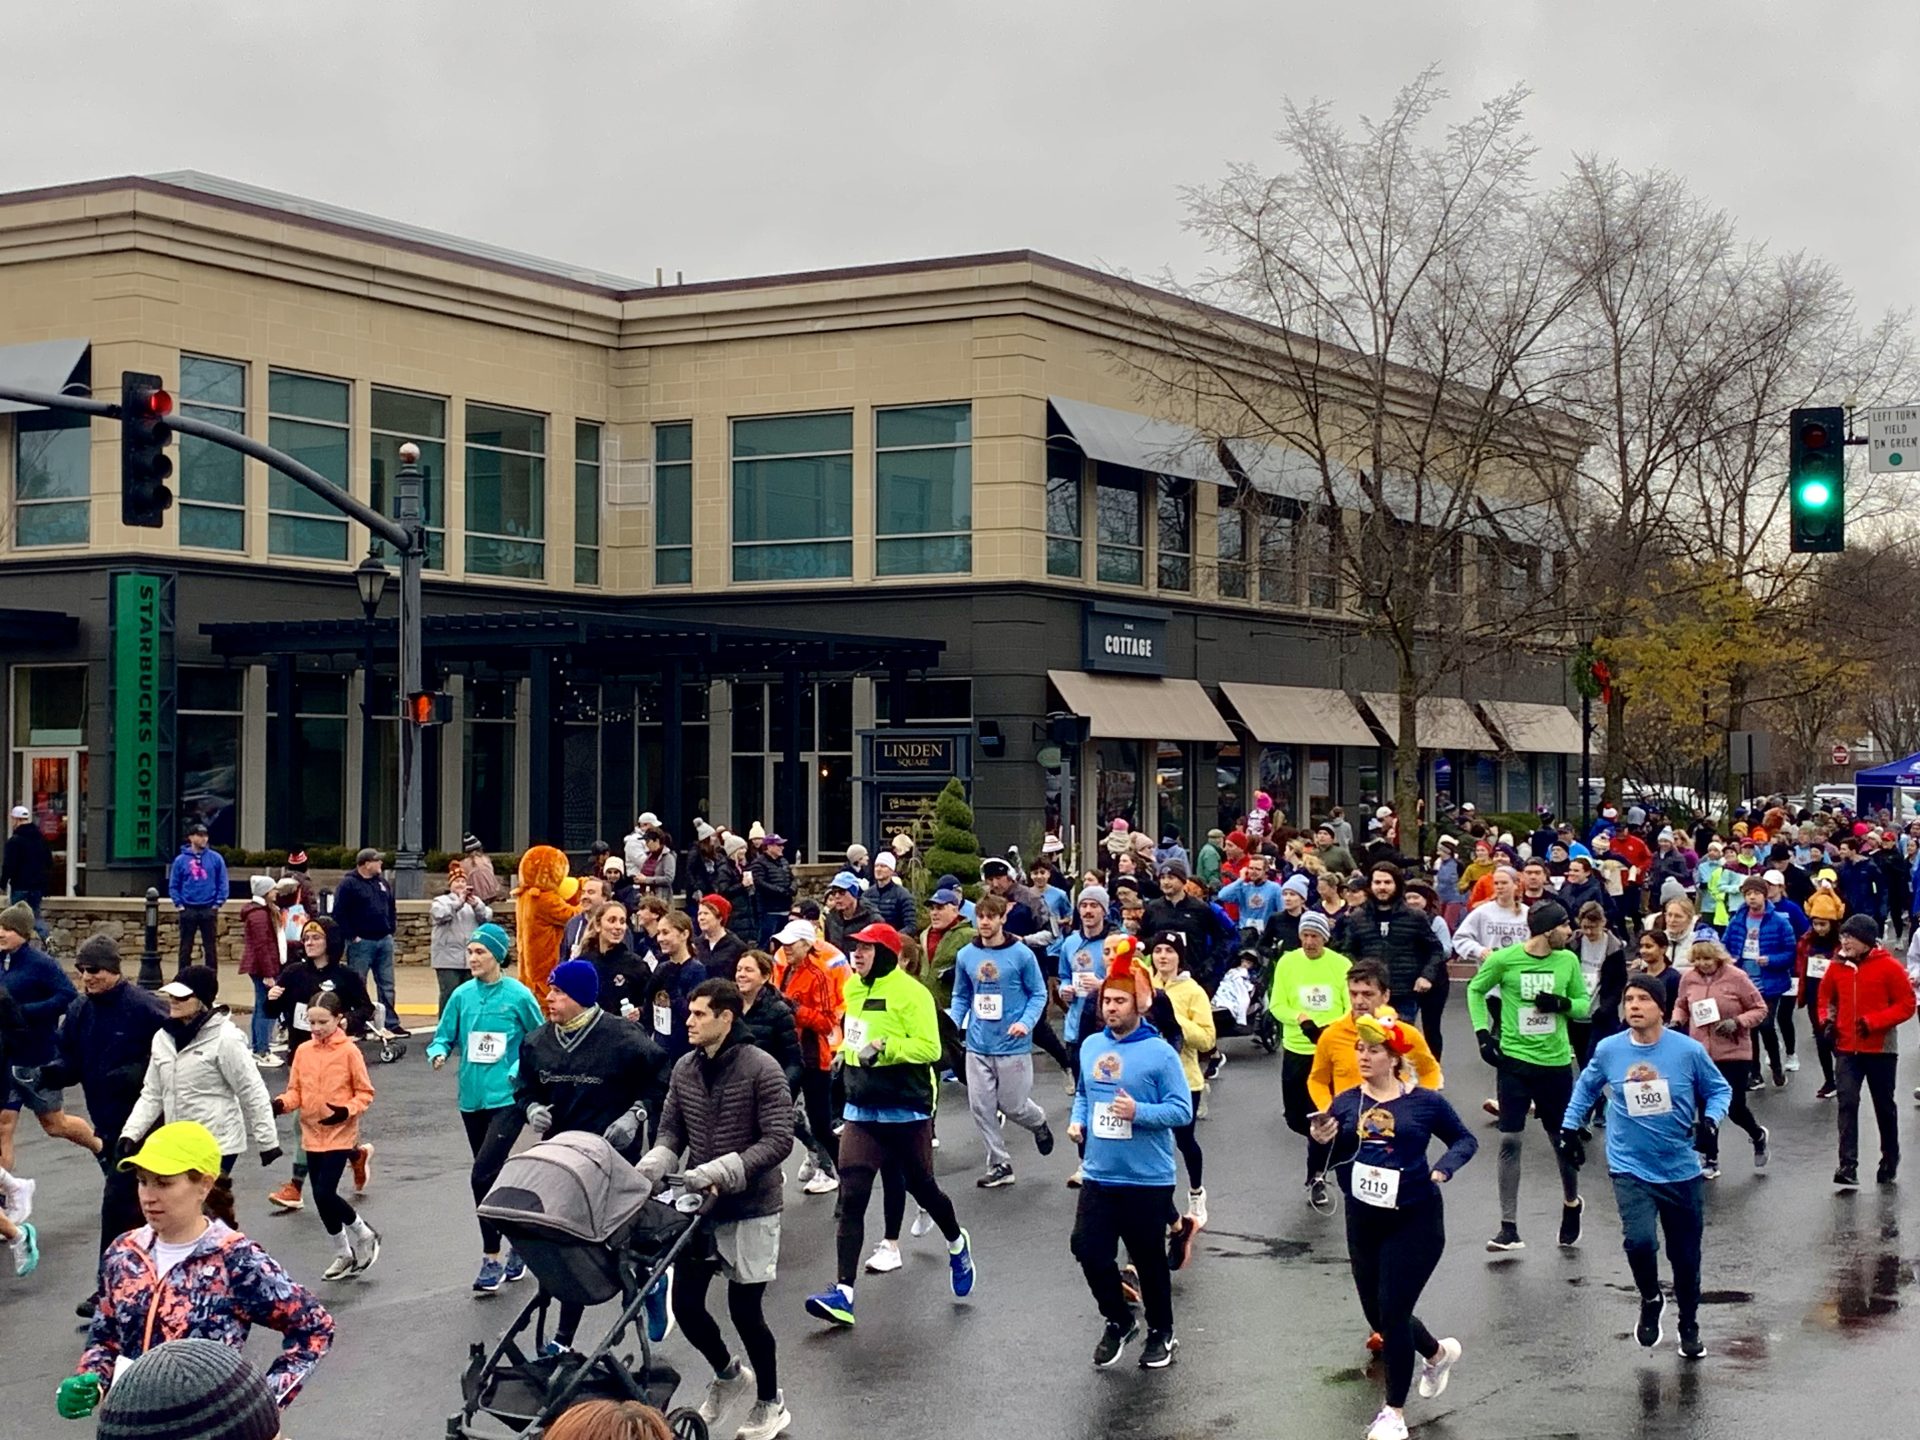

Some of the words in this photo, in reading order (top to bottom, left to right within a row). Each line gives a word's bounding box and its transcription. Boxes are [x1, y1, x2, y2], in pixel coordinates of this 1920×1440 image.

[1873, 411, 1891, 422] LEFT
[1896, 410, 1917, 420] TURN
[1884, 424, 1907, 435] YIELD
[1874, 439, 1886, 449] ON
[1890, 437, 1918, 448] GREEN
[1105, 635, 1152, 657] COTTAGE
[138, 585, 154, 743] STARBUCKS
[884, 744, 943, 757] LINDEN
[897, 758, 930, 767] SQUARE
[137, 752, 151, 850] COFFEE
[1521, 974, 1554, 987] RUN
[478, 1042, 495, 1053] 491
[1635, 1092, 1663, 1105] 1503
[1099, 1114, 1124, 1127] 2120
[1359, 1178, 1389, 1195] 2119
